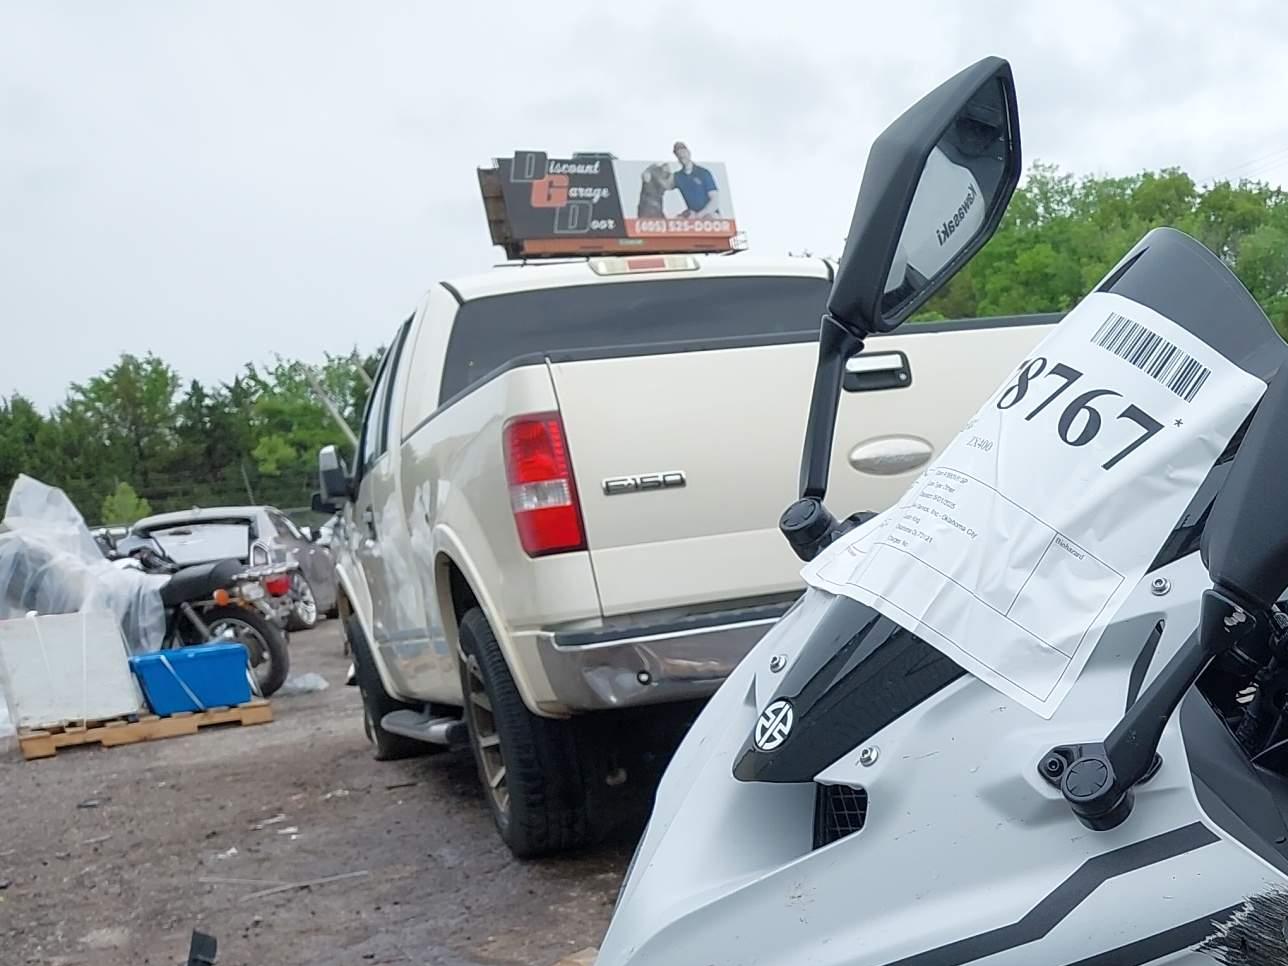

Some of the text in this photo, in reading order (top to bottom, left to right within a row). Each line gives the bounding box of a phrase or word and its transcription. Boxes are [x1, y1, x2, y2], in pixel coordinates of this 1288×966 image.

[510, 152, 600, 182] Discount
[531, 174, 610, 208] Garage
[553, 200, 616, 234] Door
[601, 470, 686, 496] F-150
